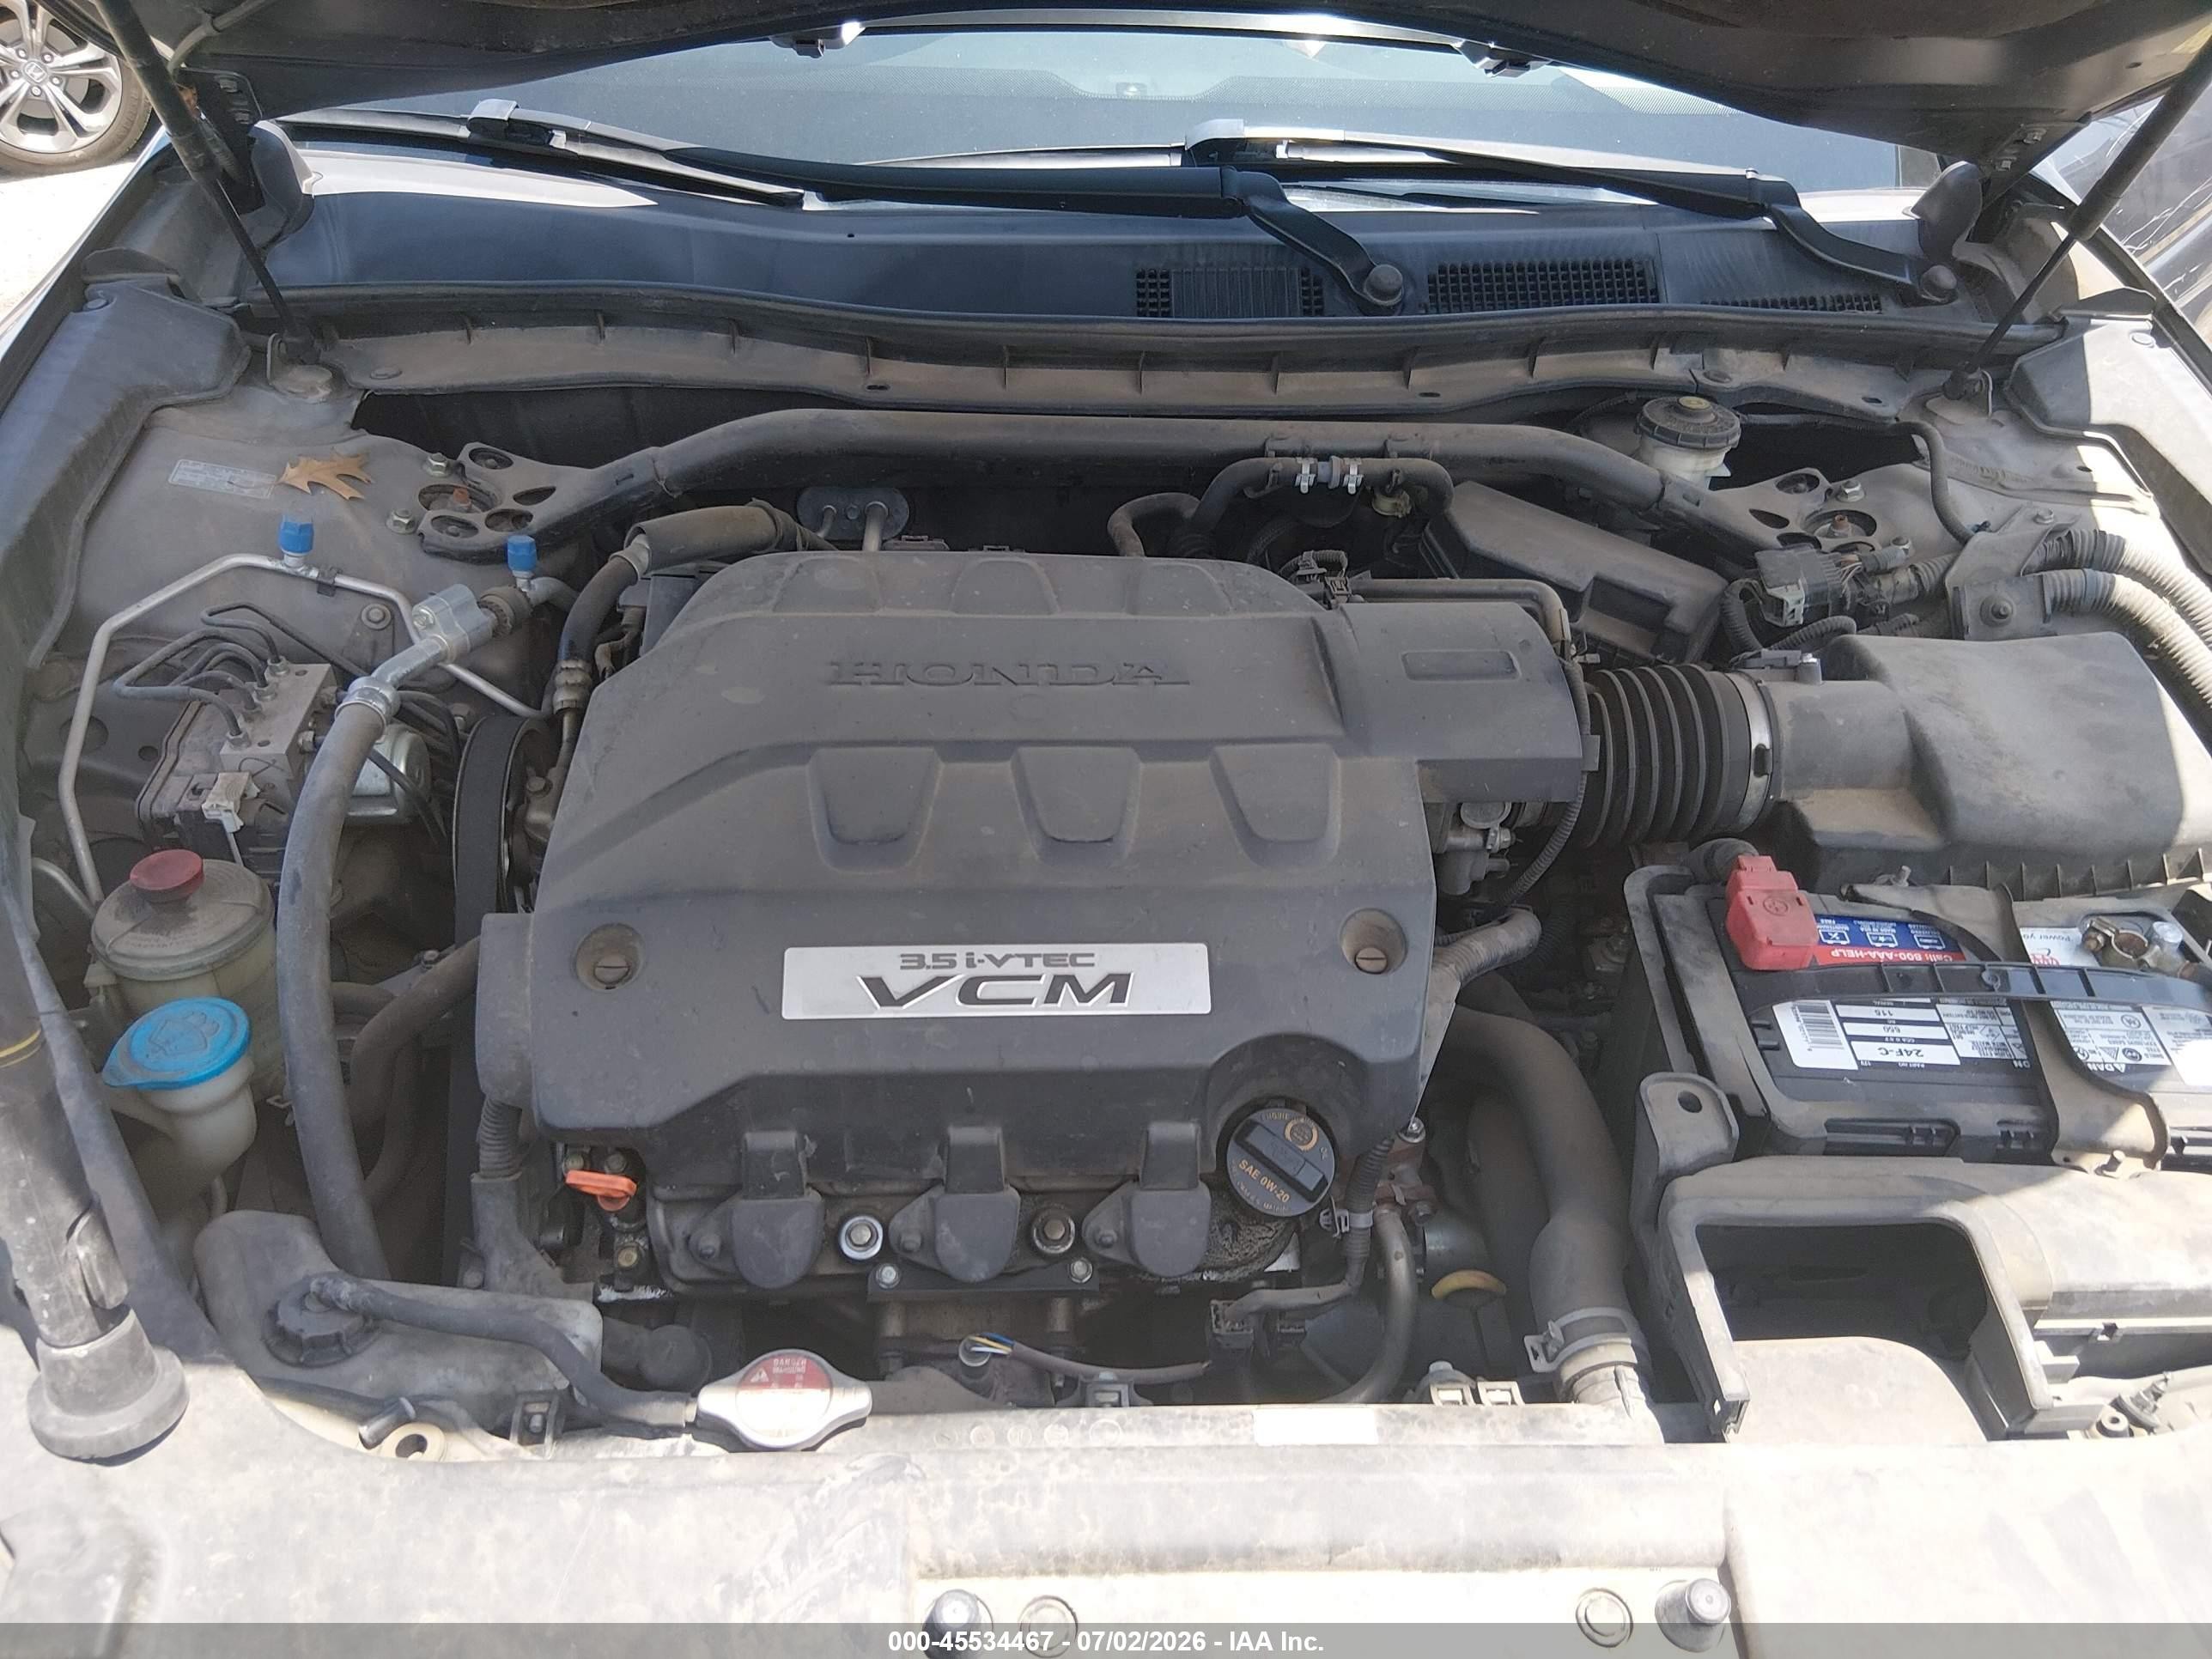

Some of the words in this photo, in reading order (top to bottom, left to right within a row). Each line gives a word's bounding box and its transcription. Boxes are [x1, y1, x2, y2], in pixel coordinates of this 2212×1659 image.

[827, 662, 1190, 685] HONDA
[900, 953, 957, 969] 3.5
[966, 952, 1094, 969] i-VTEC
[1831, 949, 1922, 961] 800-AAA-HELP
[856, 972, 1133, 1009] VCM
[1877, 1048, 1924, 1057] 24F-C
[1239, 1158, 1261, 1179] SAE
[1260, 1177, 1291, 1203] 0W-20
